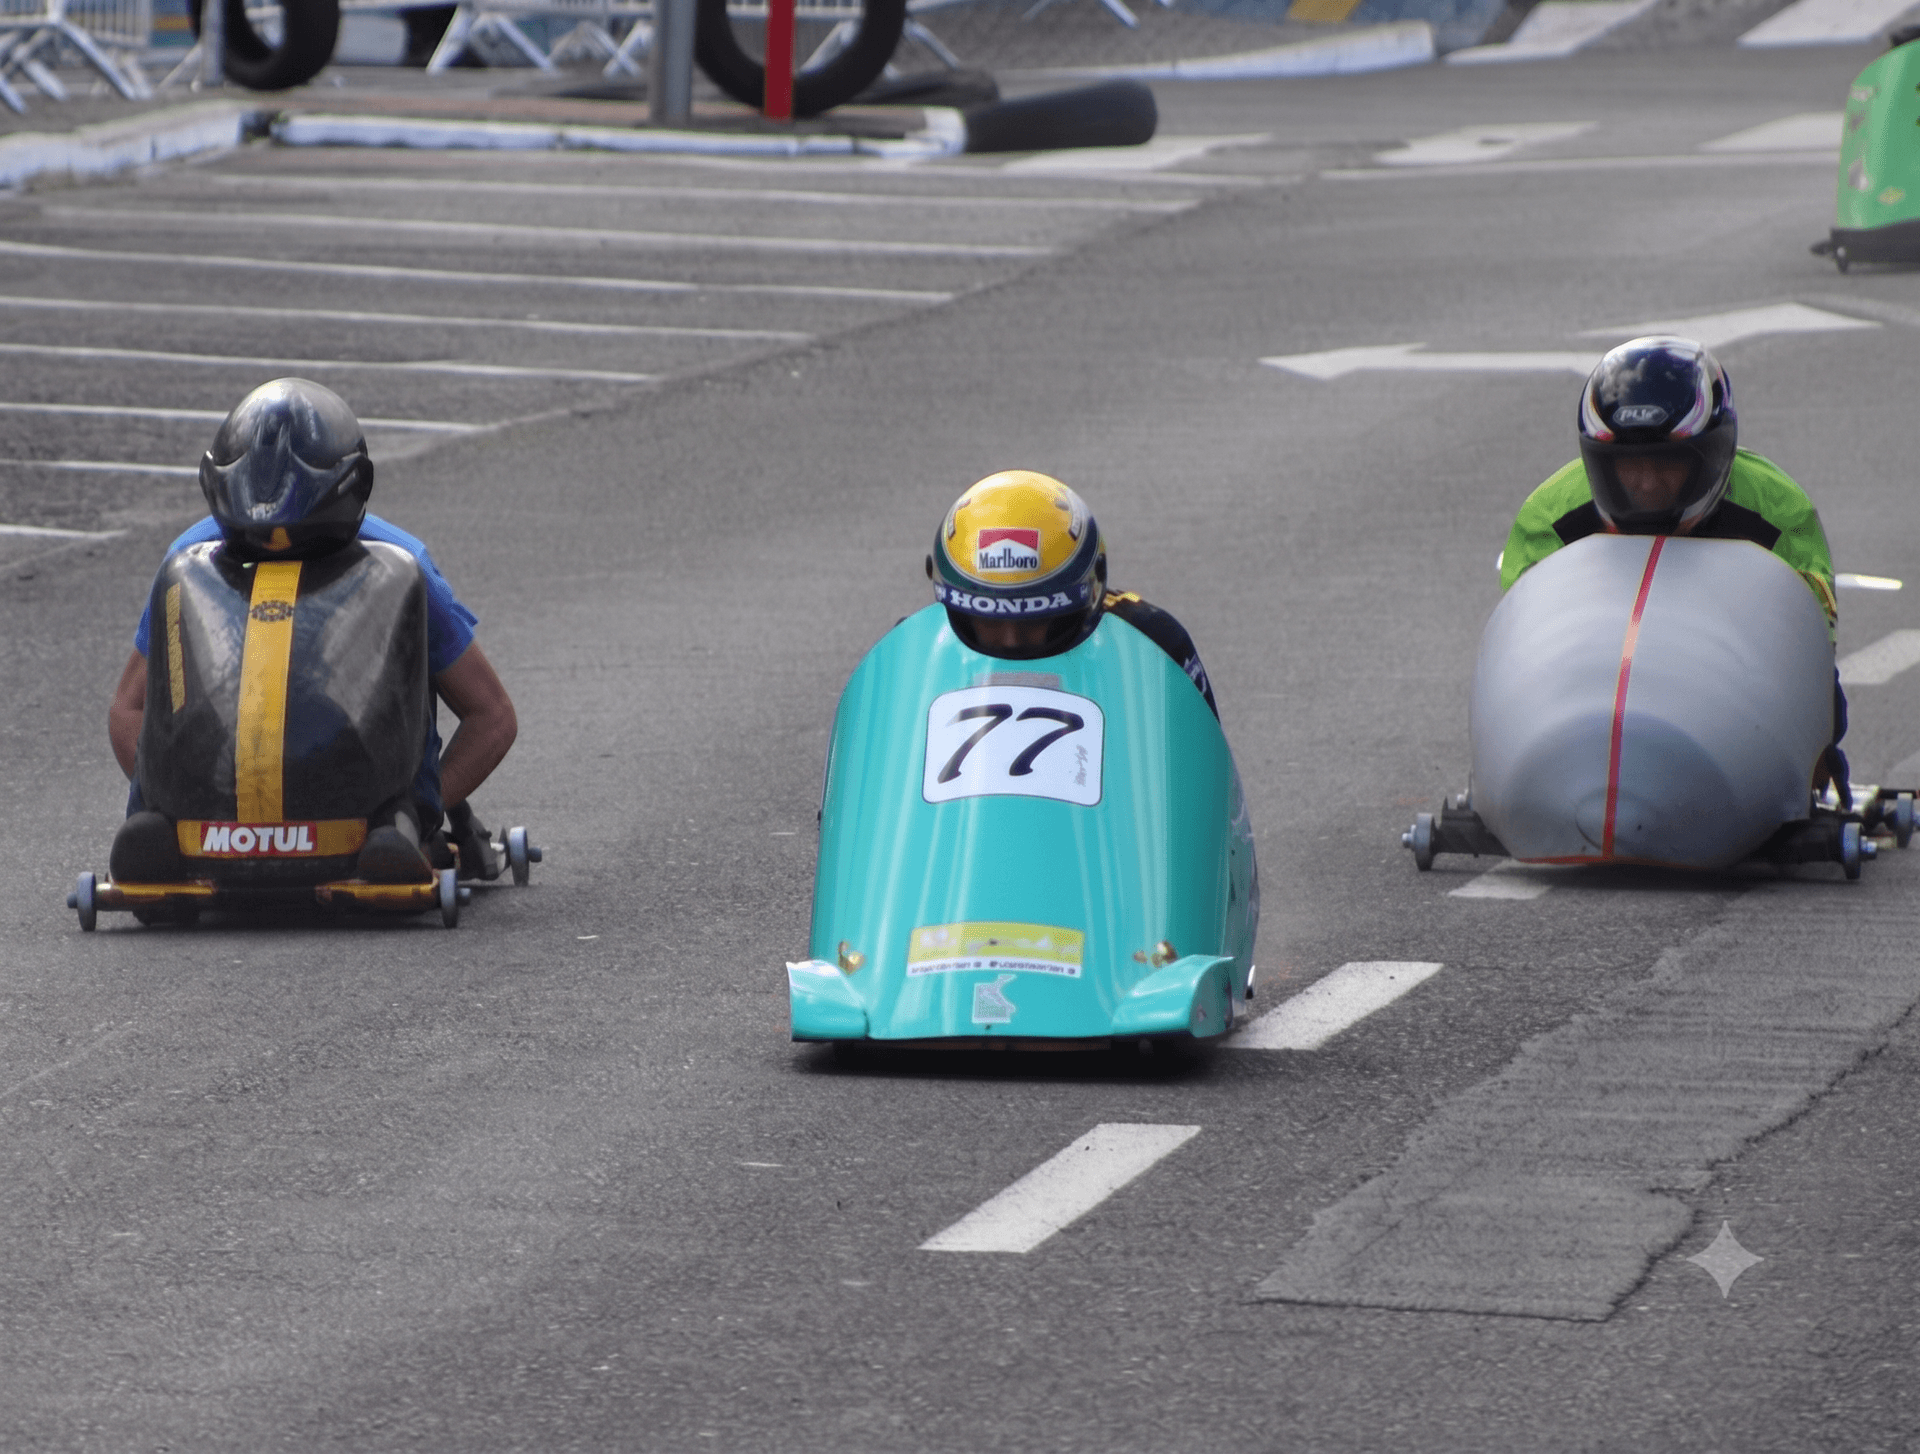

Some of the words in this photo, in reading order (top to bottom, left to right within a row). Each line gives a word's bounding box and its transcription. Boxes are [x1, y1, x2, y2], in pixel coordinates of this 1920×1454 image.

[979, 548, 1038, 569] Marlboro
[950, 590, 1073, 613] HONDA
[937, 703, 1084, 784] 77
[202, 825, 313, 853] MOTUL
